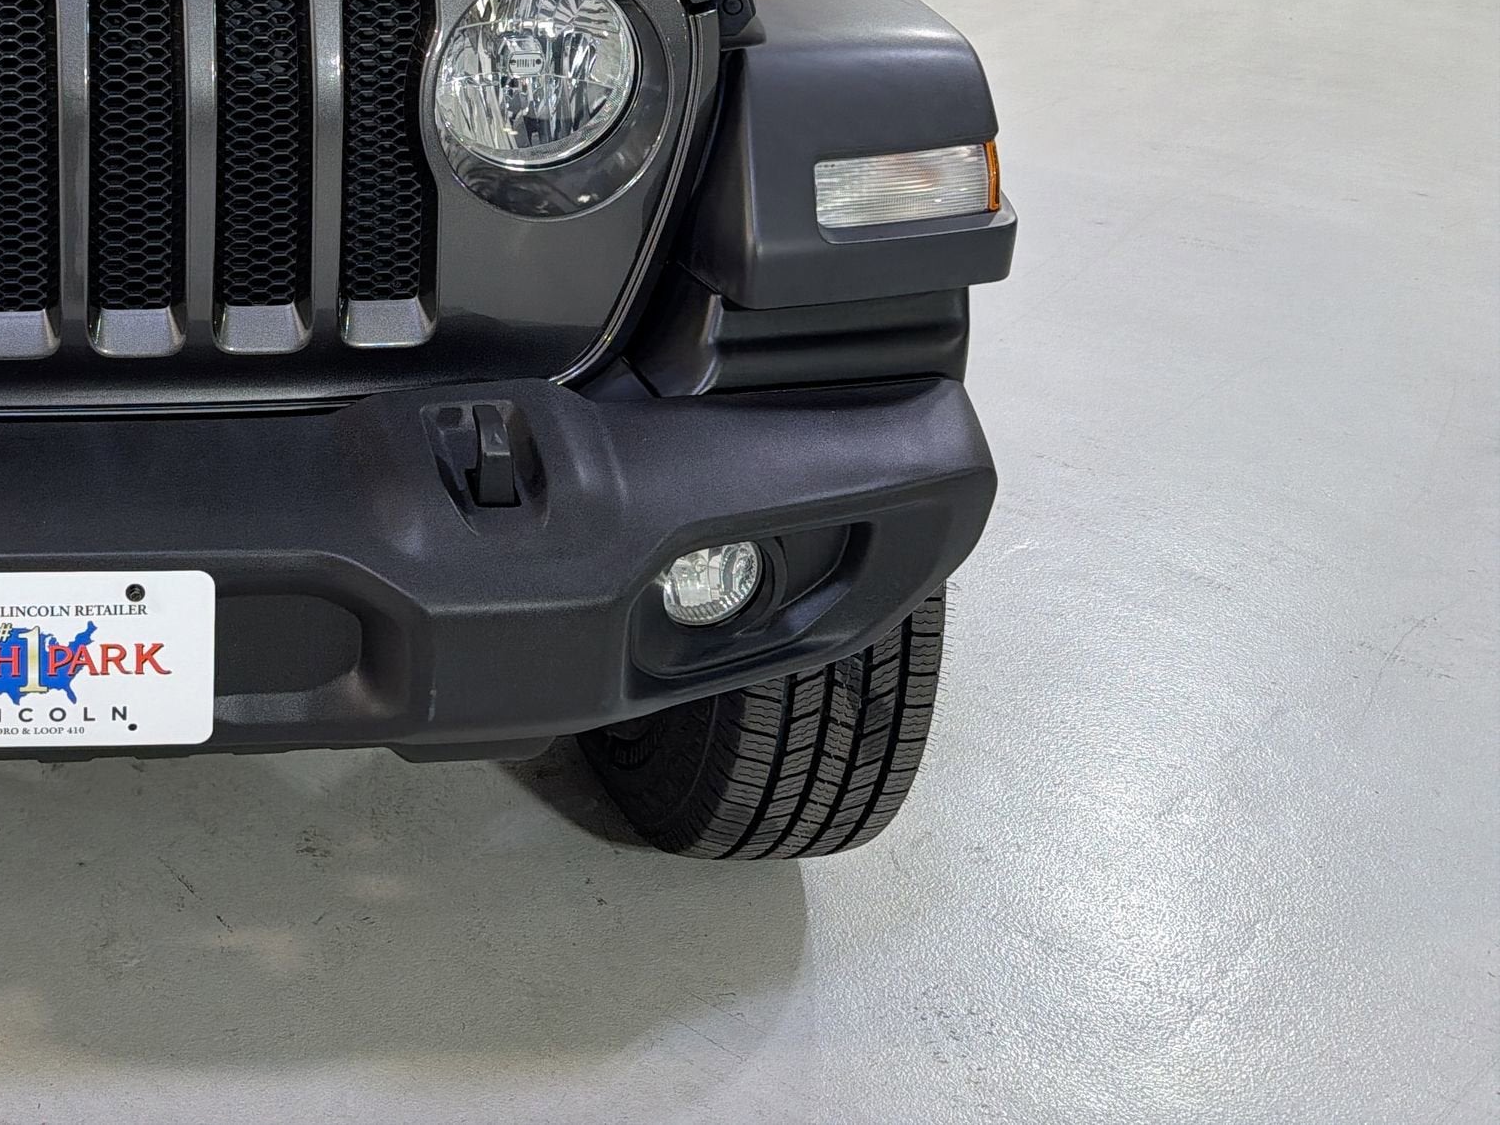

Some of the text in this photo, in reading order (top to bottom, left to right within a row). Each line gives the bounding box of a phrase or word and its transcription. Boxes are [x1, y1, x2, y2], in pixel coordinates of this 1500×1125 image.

[0, 605, 71, 618] LINCOLN
[74, 604, 148, 617] RETAILER
[47, 642, 173, 676] PARK
[21, 727, 31, 735] &
[34, 726, 65, 735] LOOP
[67, 726, 85, 735] 410
